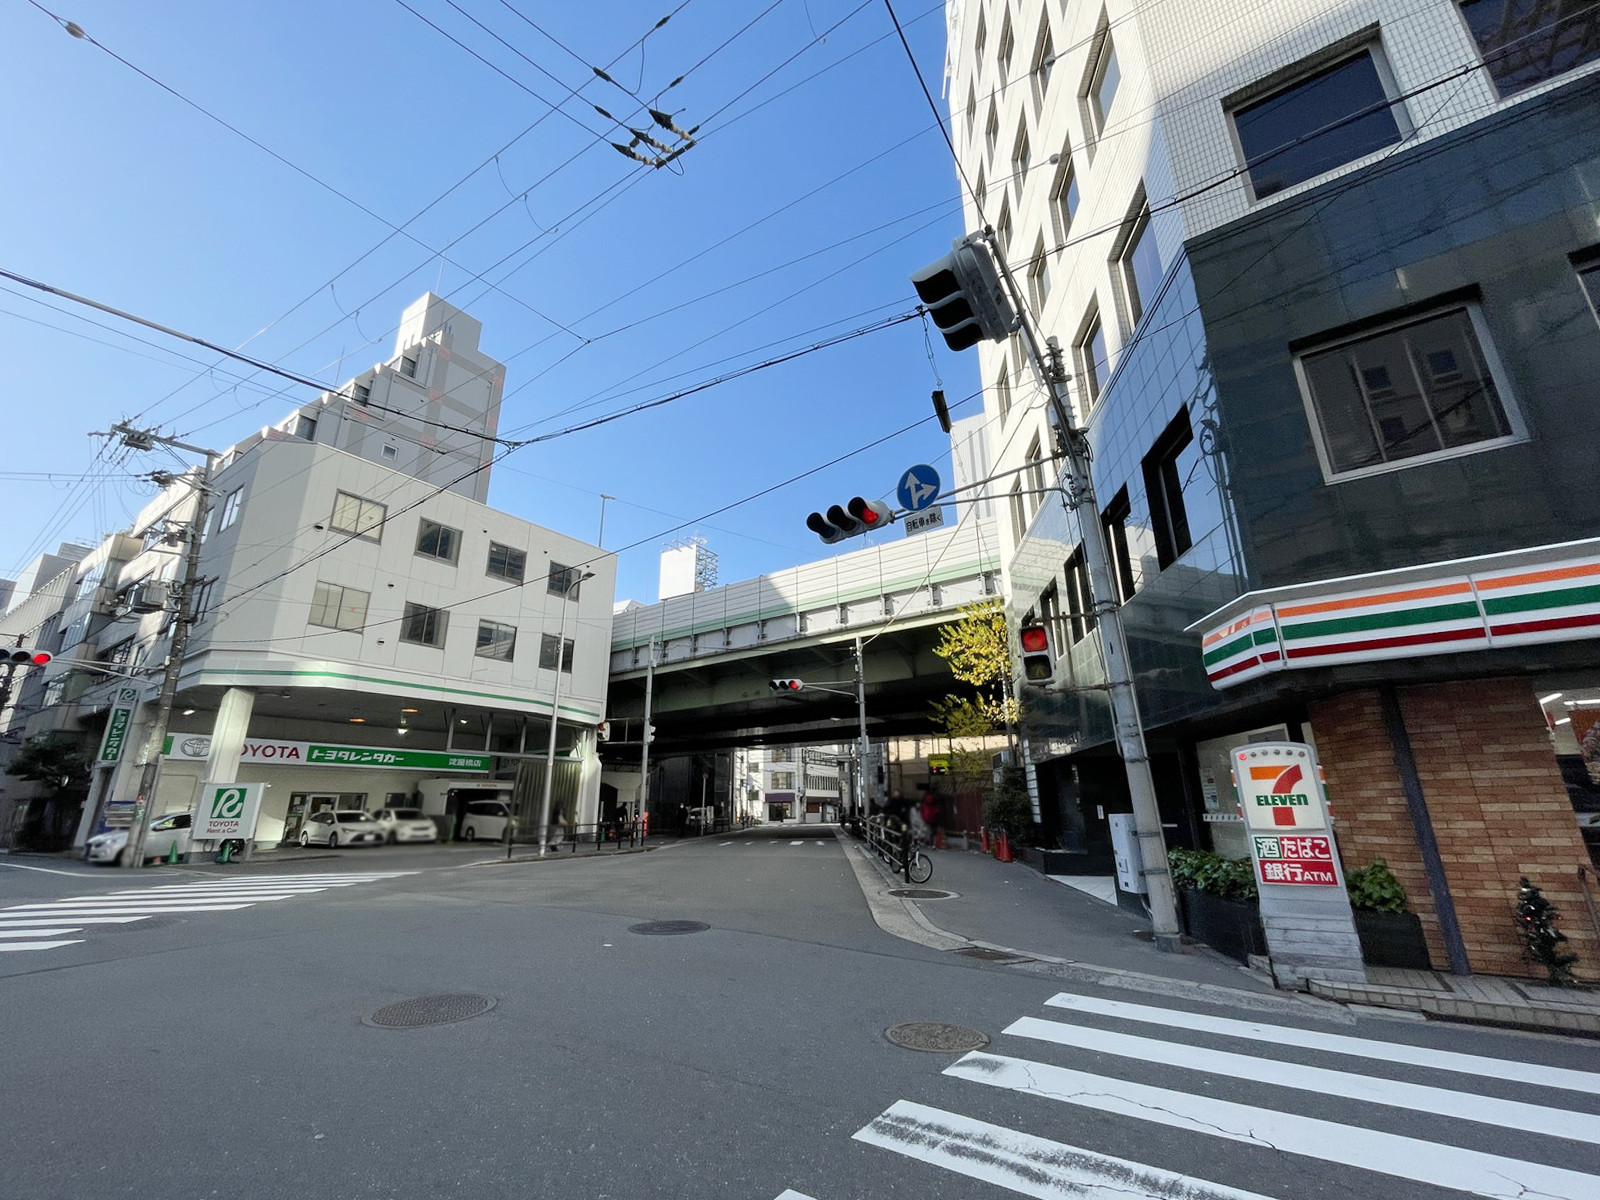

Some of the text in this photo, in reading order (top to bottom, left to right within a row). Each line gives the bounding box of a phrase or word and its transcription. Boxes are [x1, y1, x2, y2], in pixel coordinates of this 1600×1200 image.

[105, 709, 127, 760] トヨタレンタカー
[241, 744, 300, 759] YOTA
[311, 749, 404, 763] トヨタレンタカー
[1256, 838, 1330, 858] 酒 たばこ
